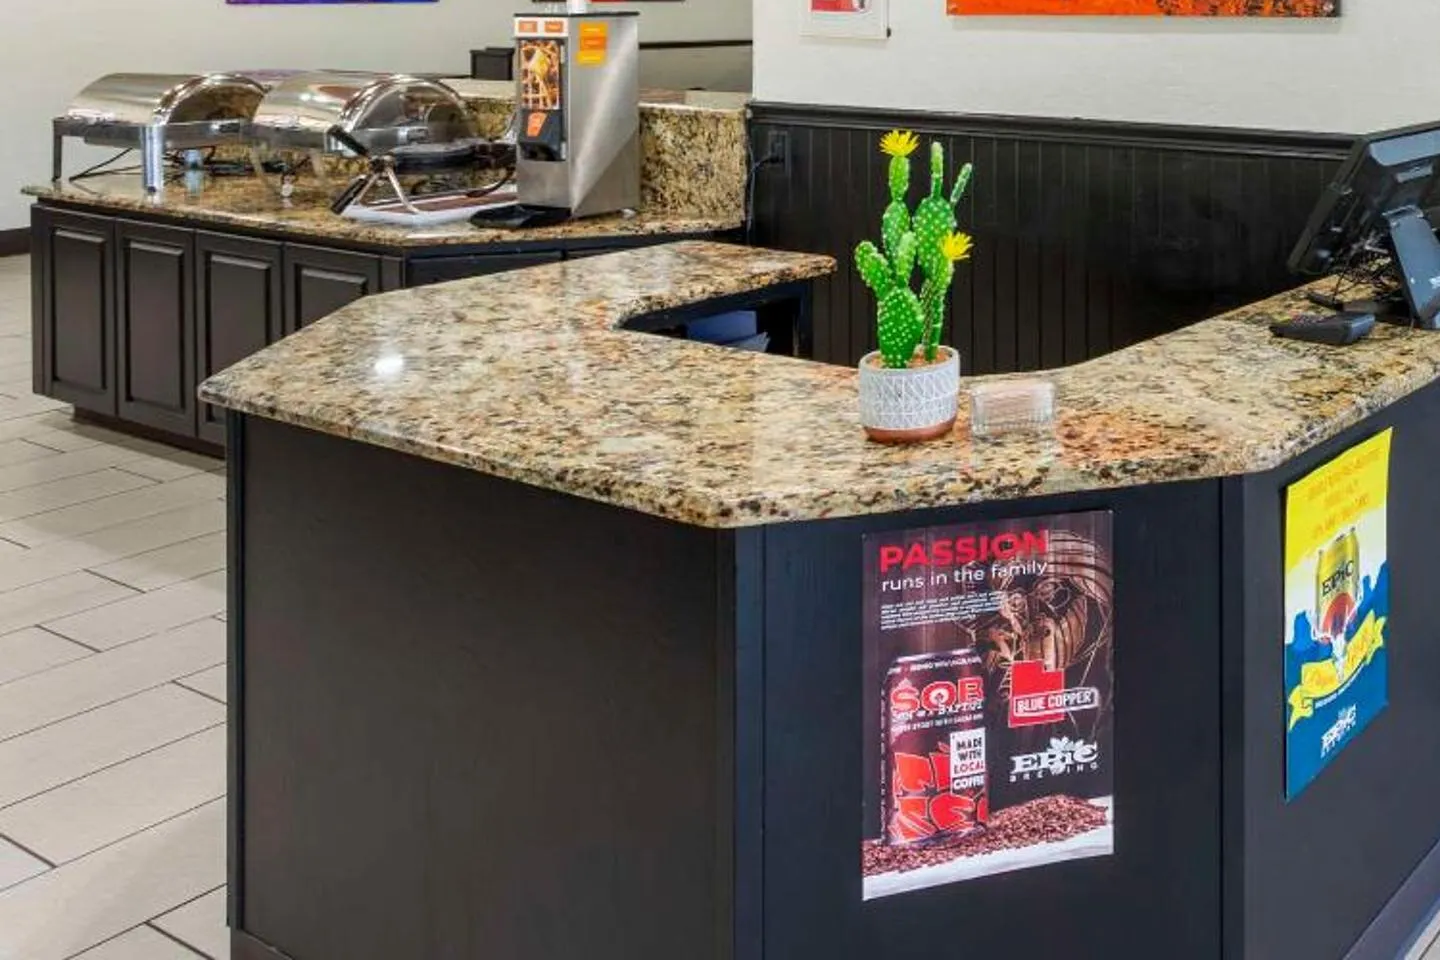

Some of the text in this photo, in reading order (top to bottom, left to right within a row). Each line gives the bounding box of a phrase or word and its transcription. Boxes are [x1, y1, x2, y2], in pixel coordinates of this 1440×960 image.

[879, 529, 1049, 574] PASSION
[882, 559, 1048, 592] runs in the family
[1016, 690, 1092, 713] BLUE COPPER
[956, 737, 982, 751] MADE
[957, 750, 982, 761] WITH
